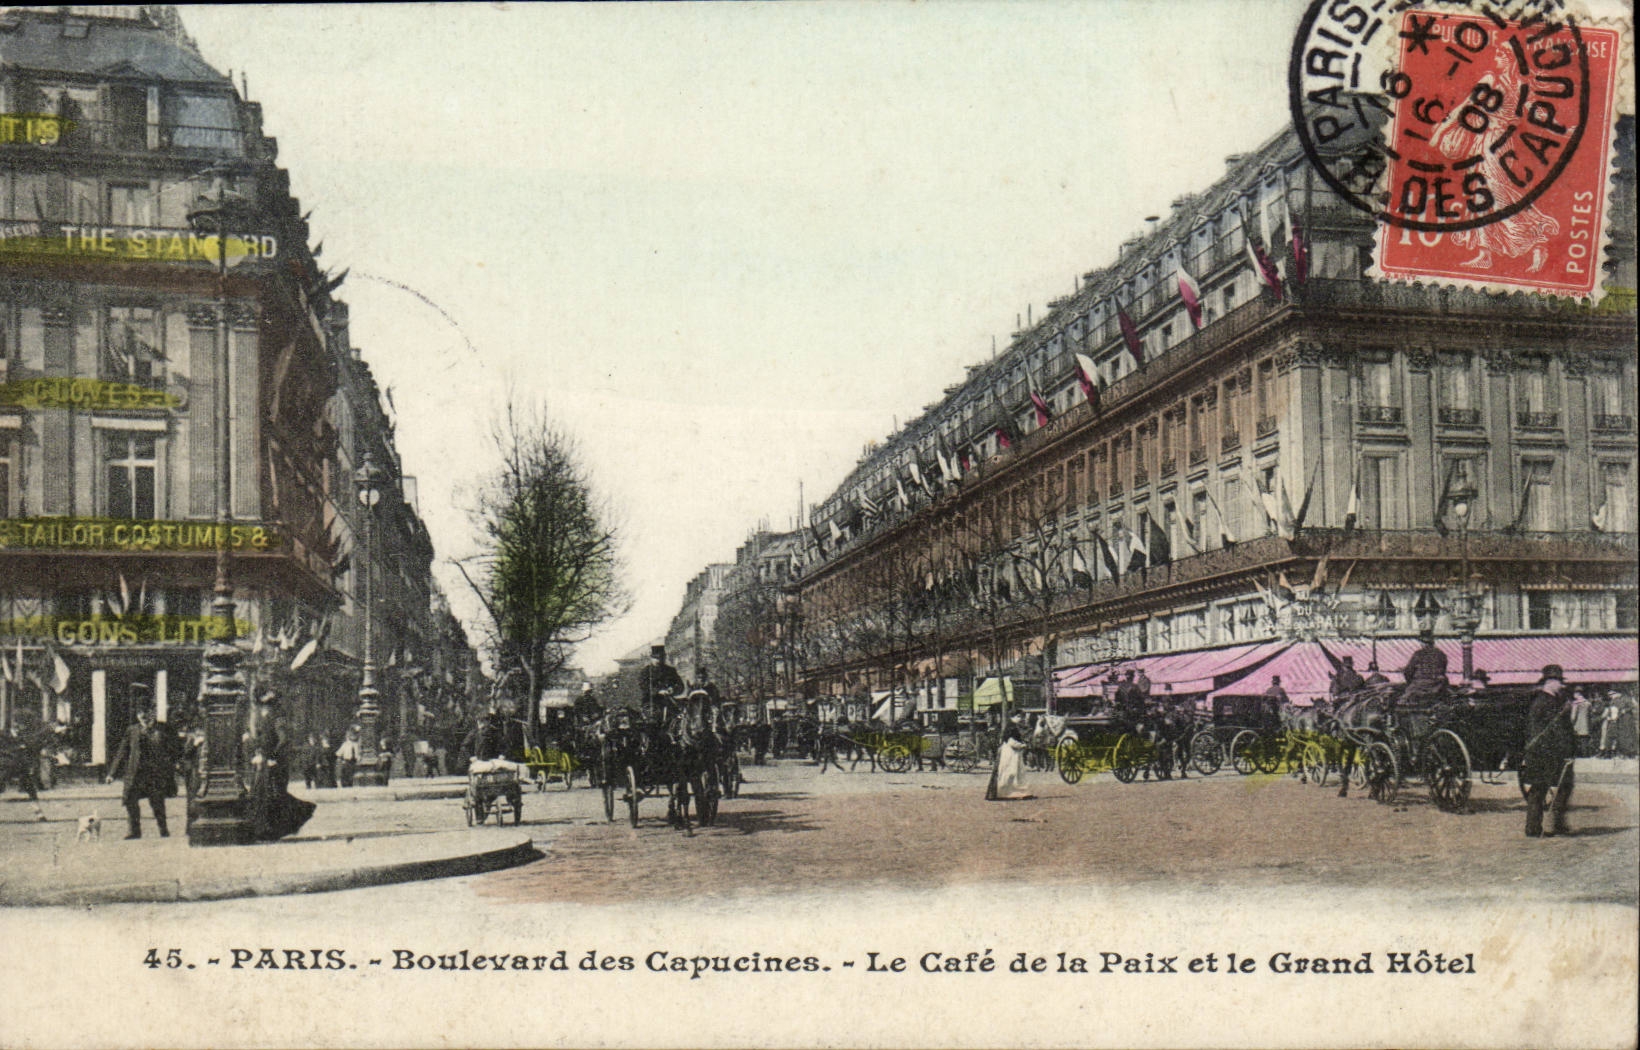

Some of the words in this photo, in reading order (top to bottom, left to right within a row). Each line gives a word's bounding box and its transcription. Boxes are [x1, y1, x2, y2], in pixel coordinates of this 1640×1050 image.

[1398, 171, 1495, 217] DES
[61, 226, 117, 252] THE
[129, 230, 278, 259] STANRD
[1566, 190, 1594, 274] POSTES
[20, 523, 105, 546] TAILOR
[251, 526, 268, 547] &
